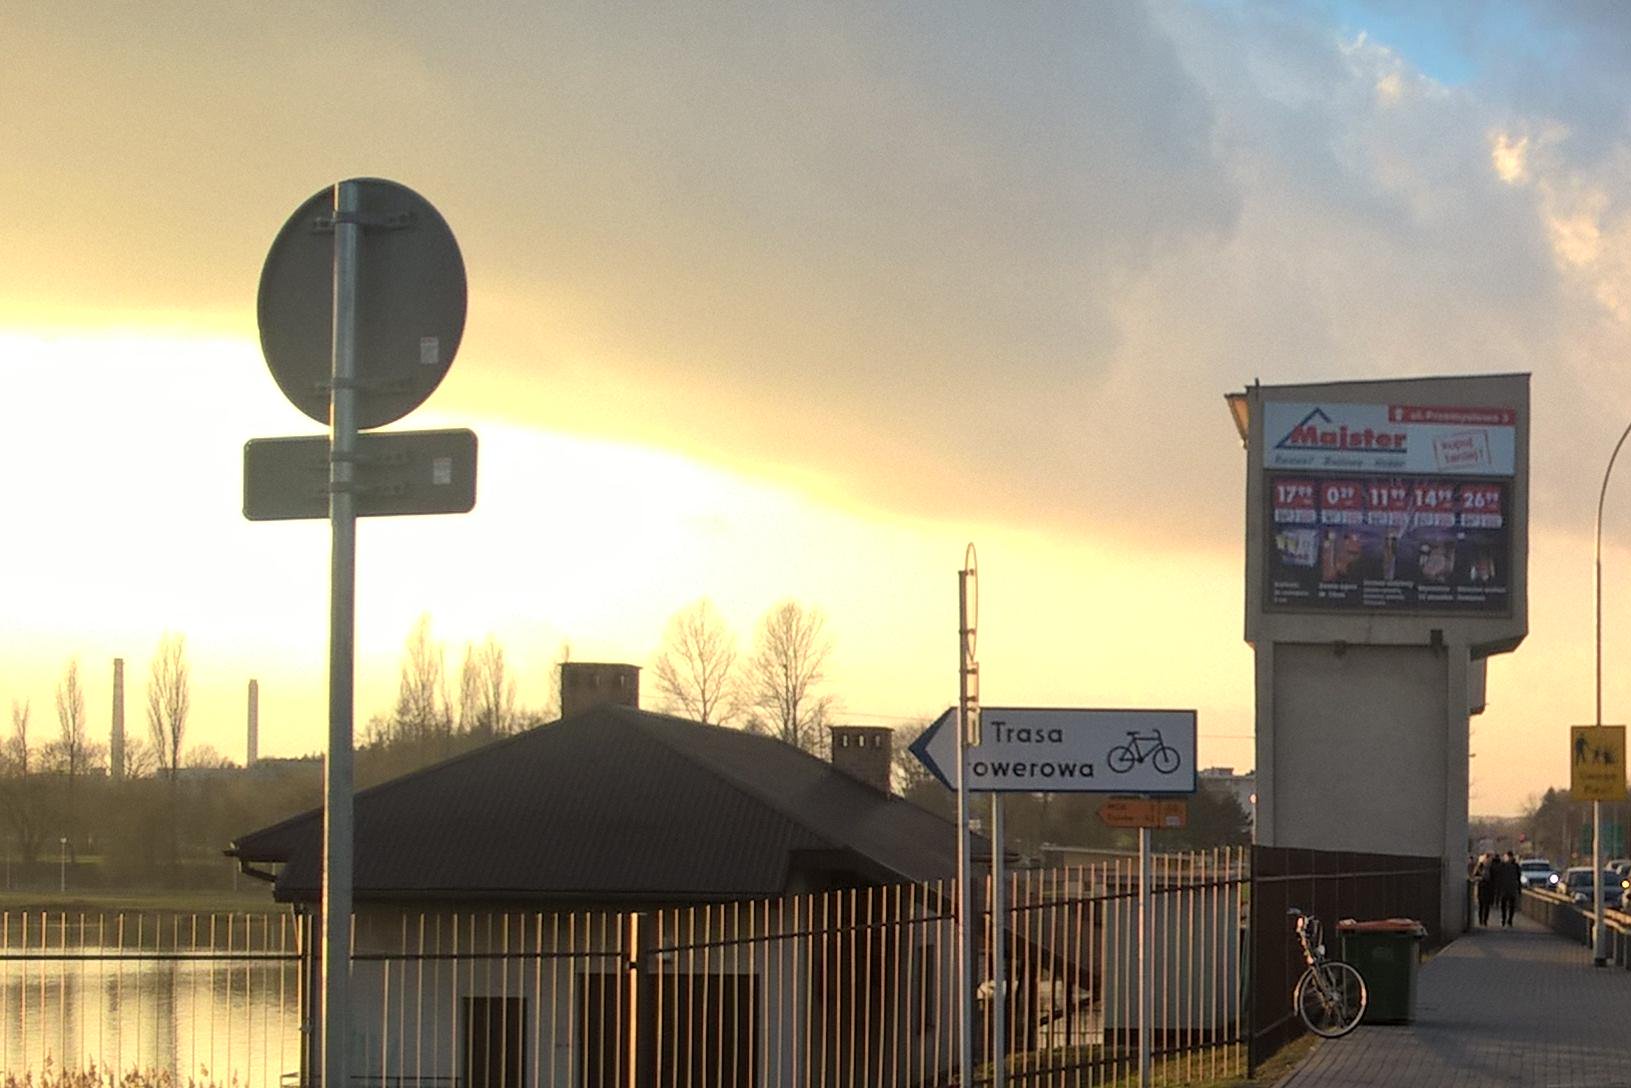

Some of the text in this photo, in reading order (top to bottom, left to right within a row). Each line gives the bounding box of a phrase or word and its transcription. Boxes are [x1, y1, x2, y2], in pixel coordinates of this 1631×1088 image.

[1289, 424, 1406, 452] Majster
[991, 720, 1063, 744] Trasa
[967, 760, 1095, 779] owerowa
